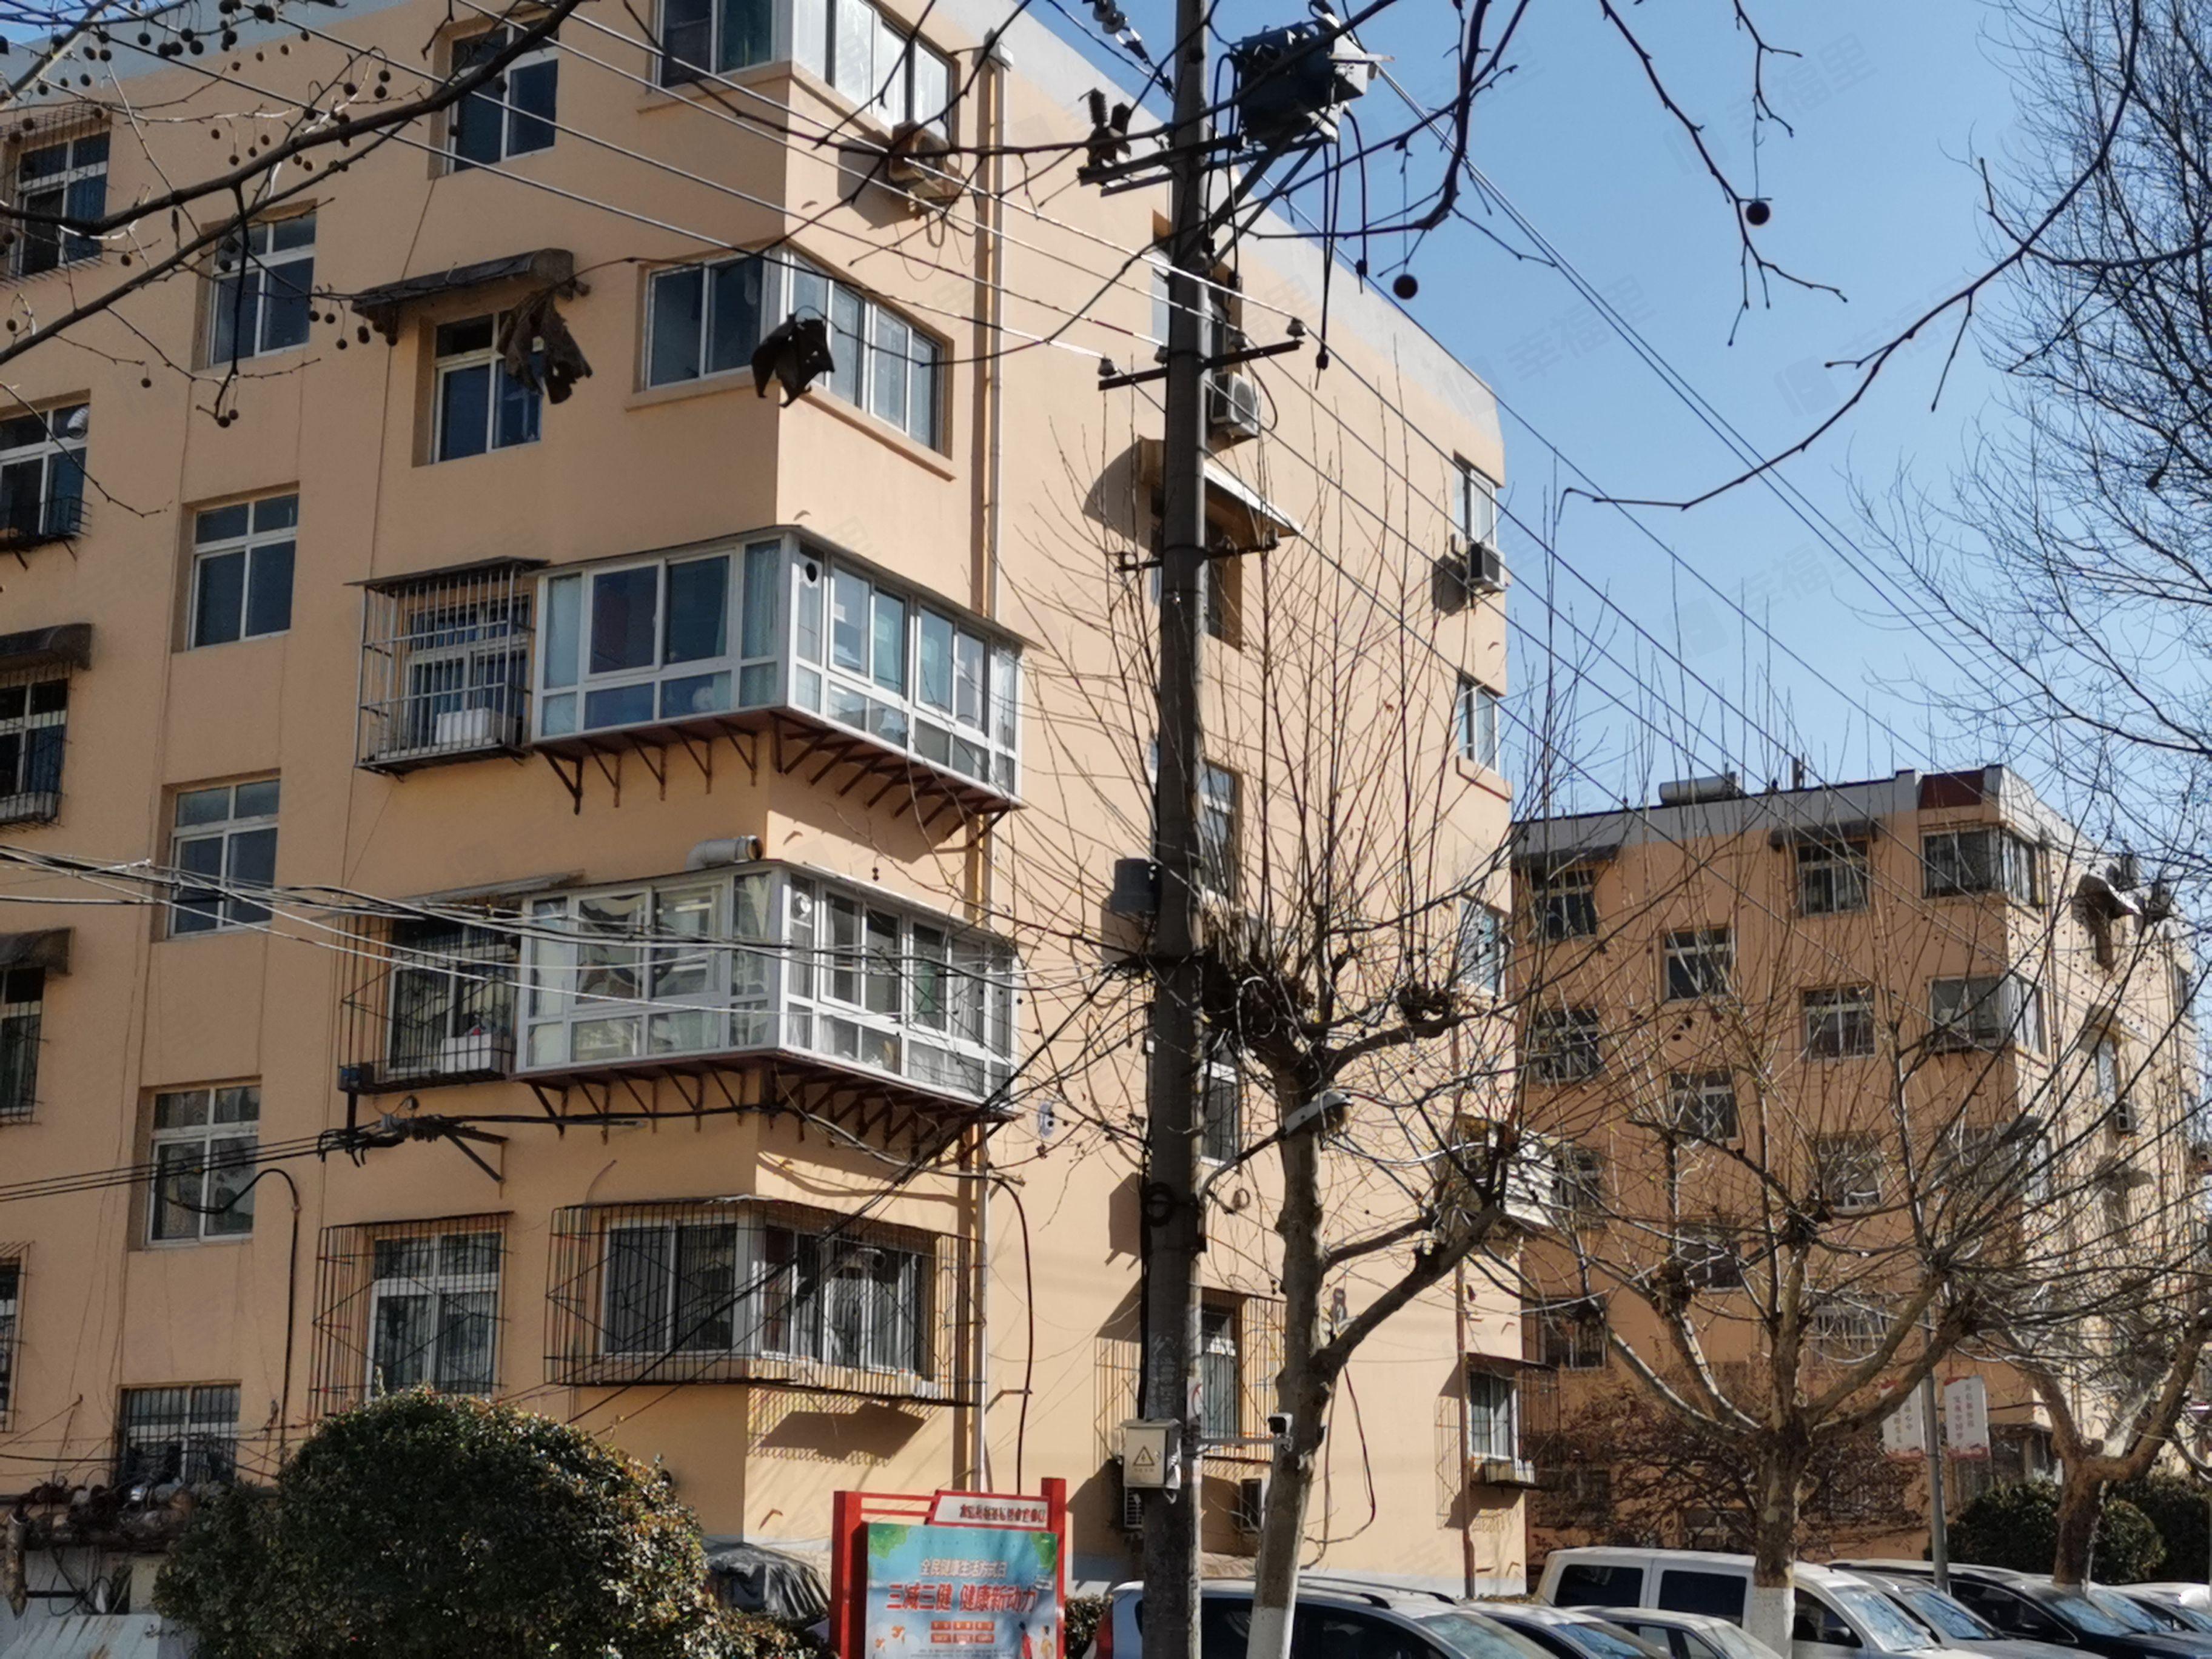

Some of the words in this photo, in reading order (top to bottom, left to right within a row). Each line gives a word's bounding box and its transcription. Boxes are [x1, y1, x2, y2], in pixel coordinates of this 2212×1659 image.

[886, 1582, 953, 1612] 三减三健
[959, 1582, 1039, 1613] 健康新动力
